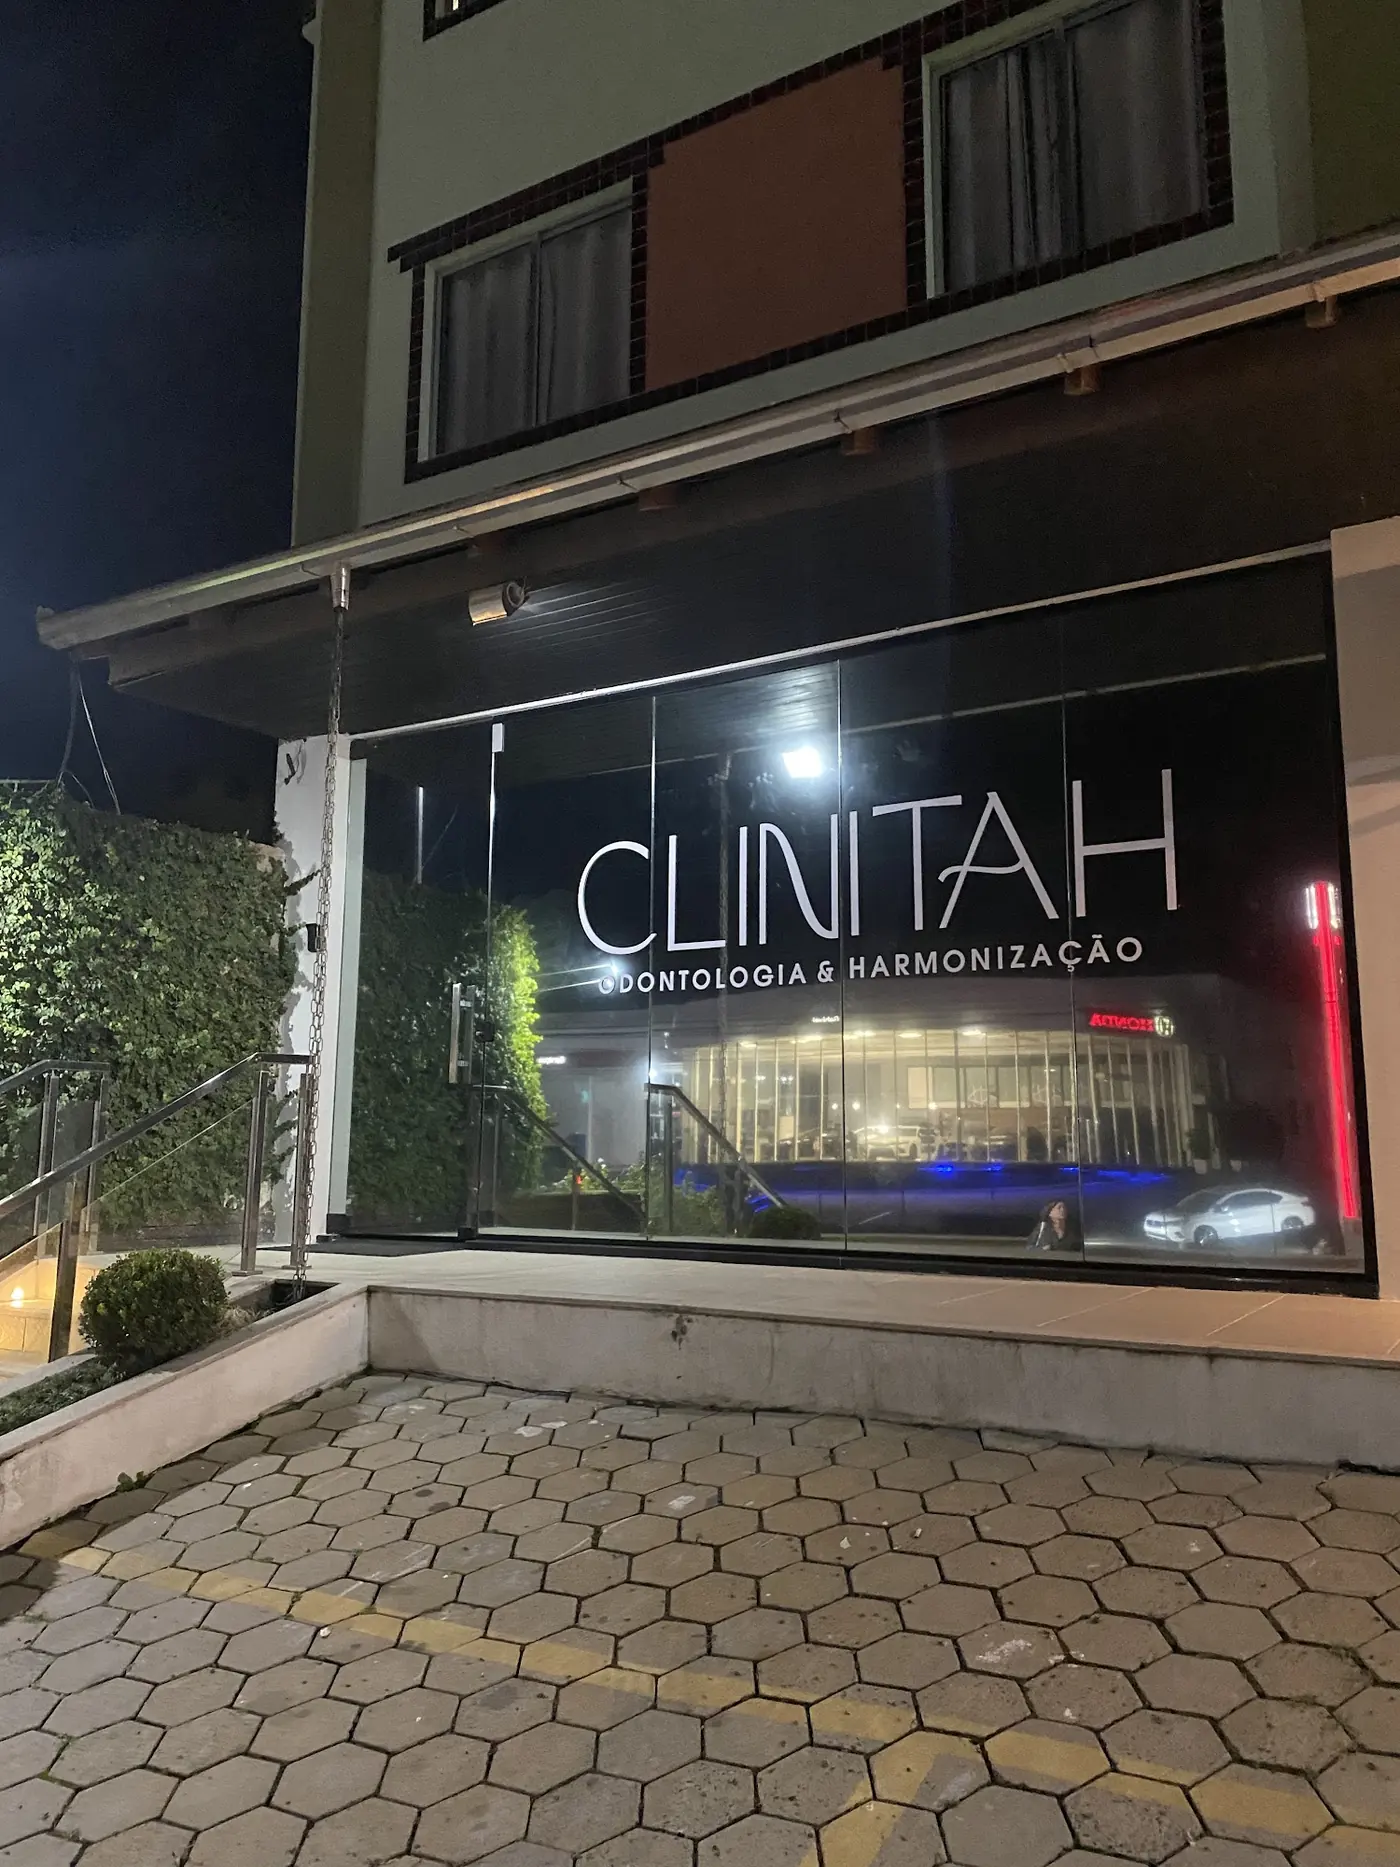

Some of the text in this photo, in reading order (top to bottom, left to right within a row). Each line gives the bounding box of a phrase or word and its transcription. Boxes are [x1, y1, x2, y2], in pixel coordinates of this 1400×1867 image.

[577, 769, 1178, 955] CLINITAH
[599, 934, 1143, 995] ODONTOLOGIA & HARMONIZAÇÃO
